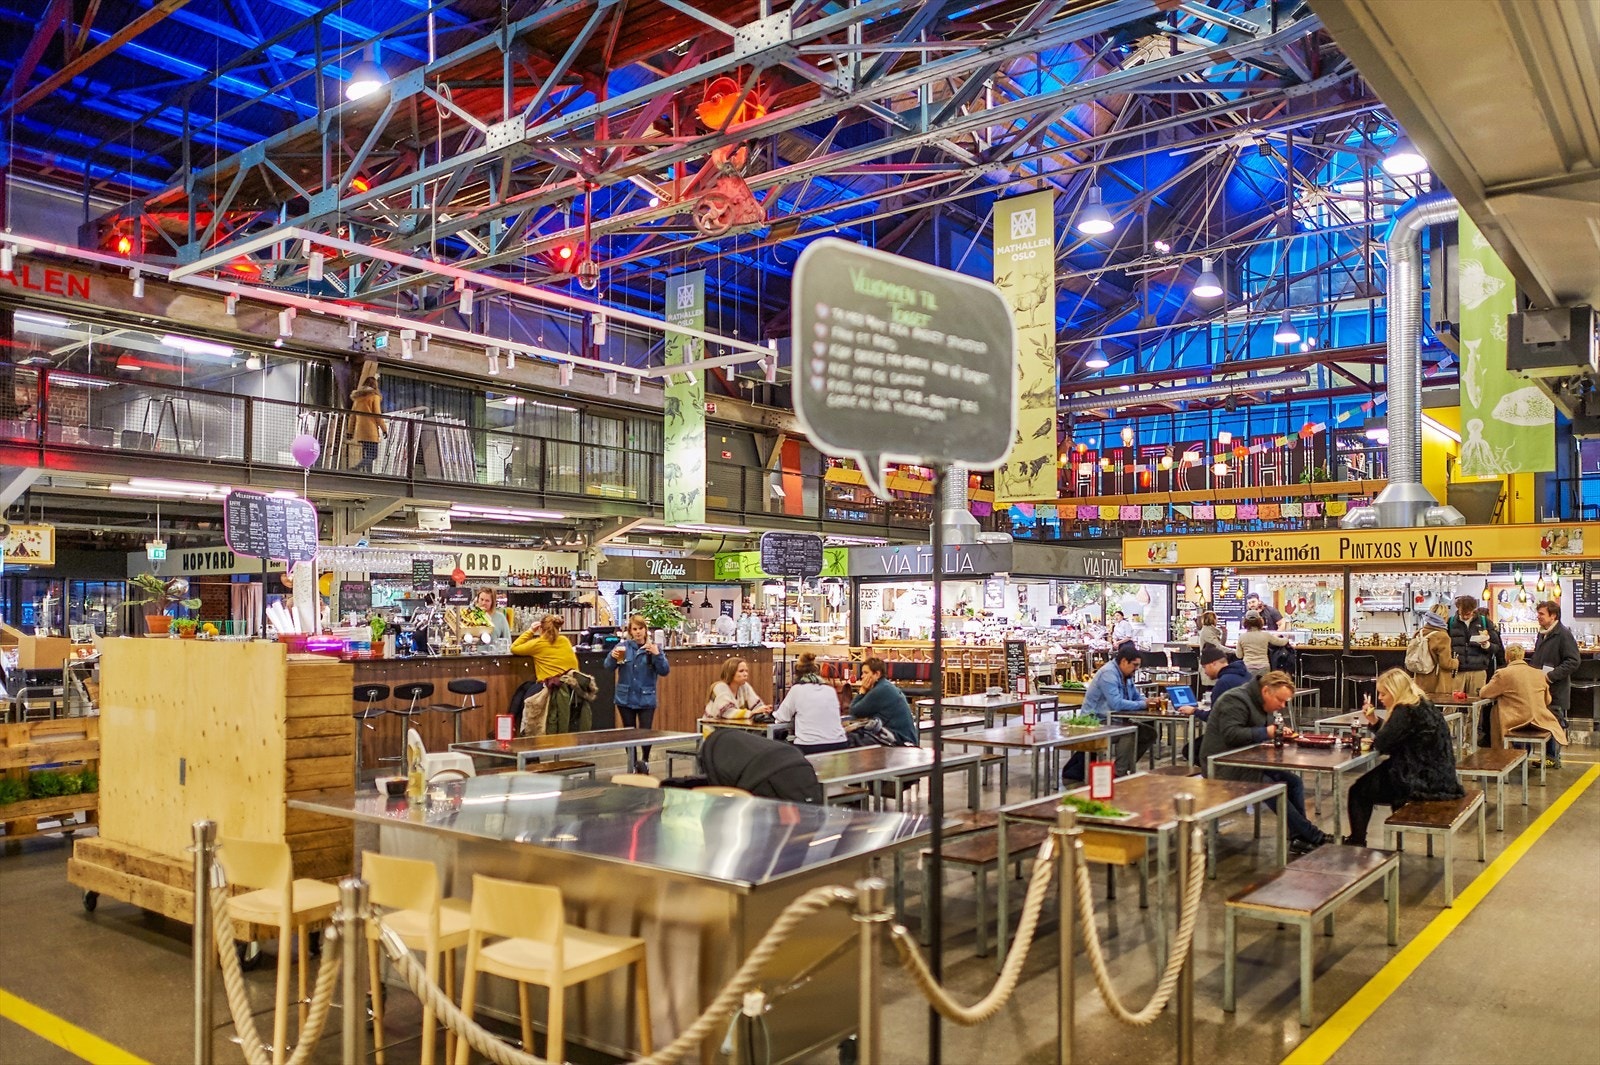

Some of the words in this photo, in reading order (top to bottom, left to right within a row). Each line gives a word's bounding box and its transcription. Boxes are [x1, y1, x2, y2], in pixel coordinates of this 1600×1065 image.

[997, 238, 1051, 255] MATHALLEN
[1011, 250, 1036, 261] OSLO
[668, 309, 704, 321] MATHALLEN
[1230, 540, 1320, 562] Barramón
[1339, 537, 1401, 559] PINTXOS
[1409, 541, 1418, 558] Y
[1424, 534, 1473, 558] VINOS
[182, 551, 235, 571] HOPYARD
[646, 558, 686, 576] Mildrids
[881, 554, 912, 574] VIA
[917, 552, 975, 573] ITLIA
[1083, 556, 1101, 576] VIA
